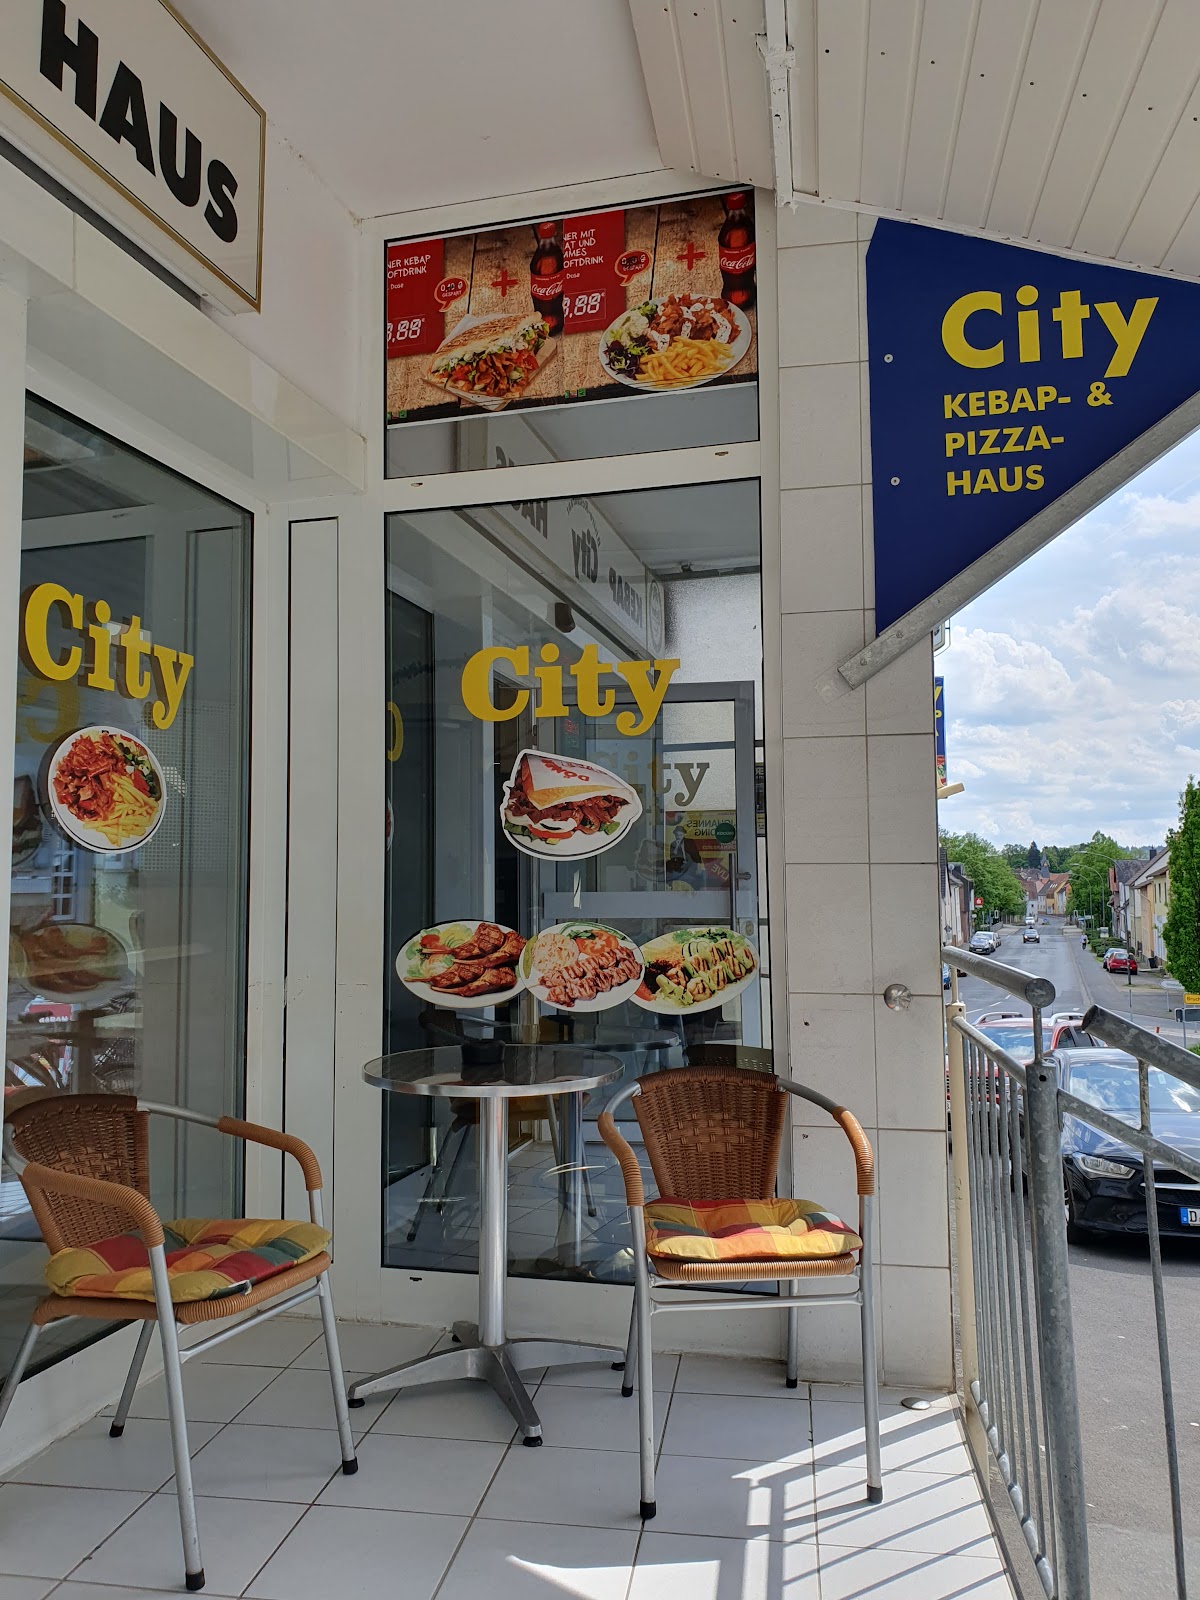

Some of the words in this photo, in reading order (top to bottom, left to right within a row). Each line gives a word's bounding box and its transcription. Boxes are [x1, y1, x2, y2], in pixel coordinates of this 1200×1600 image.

[40, 0, 239, 243] HAUS
[578, 237, 596, 247] UND
[580, 229, 596, 238] MIT
[387, 266, 427, 279] OFTDRINK
[404, 254, 431, 265] KEBAP
[563, 255, 604, 269] OFTDRINK
[720, 252, 755, 270] Coca-Cola
[941, 284, 1160, 378] City
[943, 385, 1071, 419] KEBAP-
[1086, 381, 1114, 407] &
[945, 425, 1065, 458] PIZZA-
[946, 464, 1045, 496] HAUS
[24, 582, 195, 730] City
[460, 642, 681, 737] City
